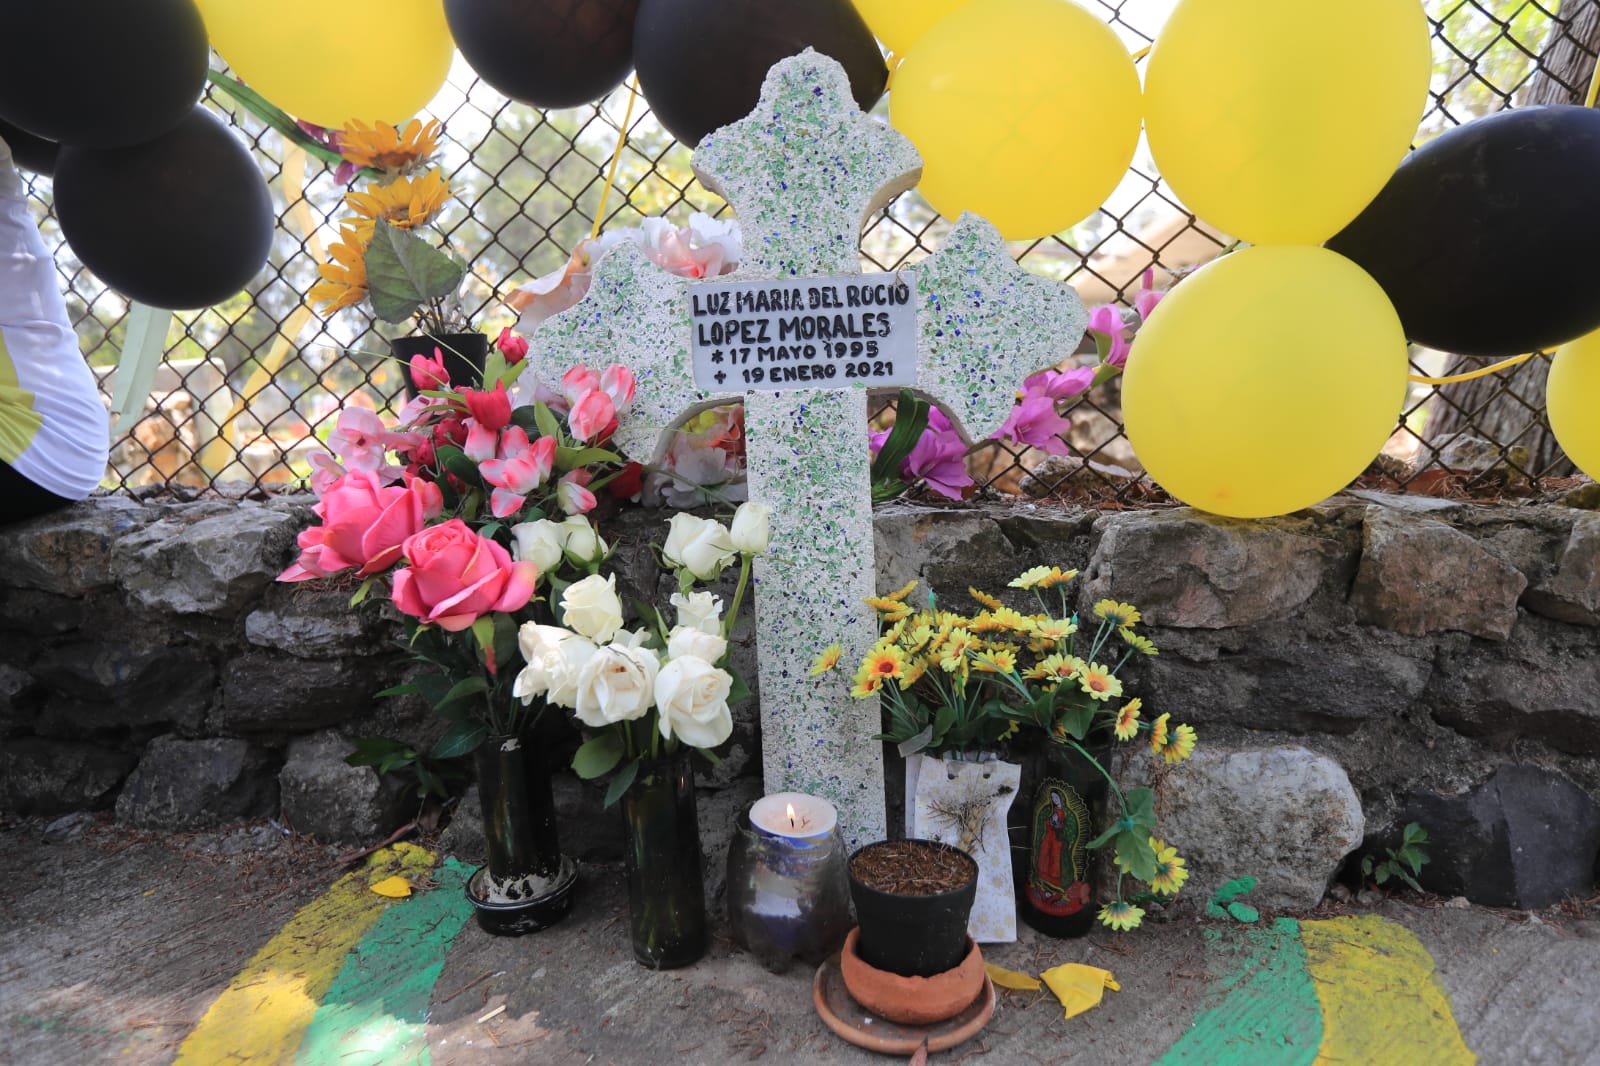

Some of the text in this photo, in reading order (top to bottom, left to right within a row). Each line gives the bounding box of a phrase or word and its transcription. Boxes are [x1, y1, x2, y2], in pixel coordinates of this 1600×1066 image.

[693, 292, 731, 317] LUZ
[736, 288, 804, 314] MARIA
[808, 286, 844, 310] DEL
[698, 312, 892, 346] LOPEZ MORALES
[729, 341, 879, 364] 17 MAYO 1995
[742, 361, 893, 383] 19 ENERO 2021
